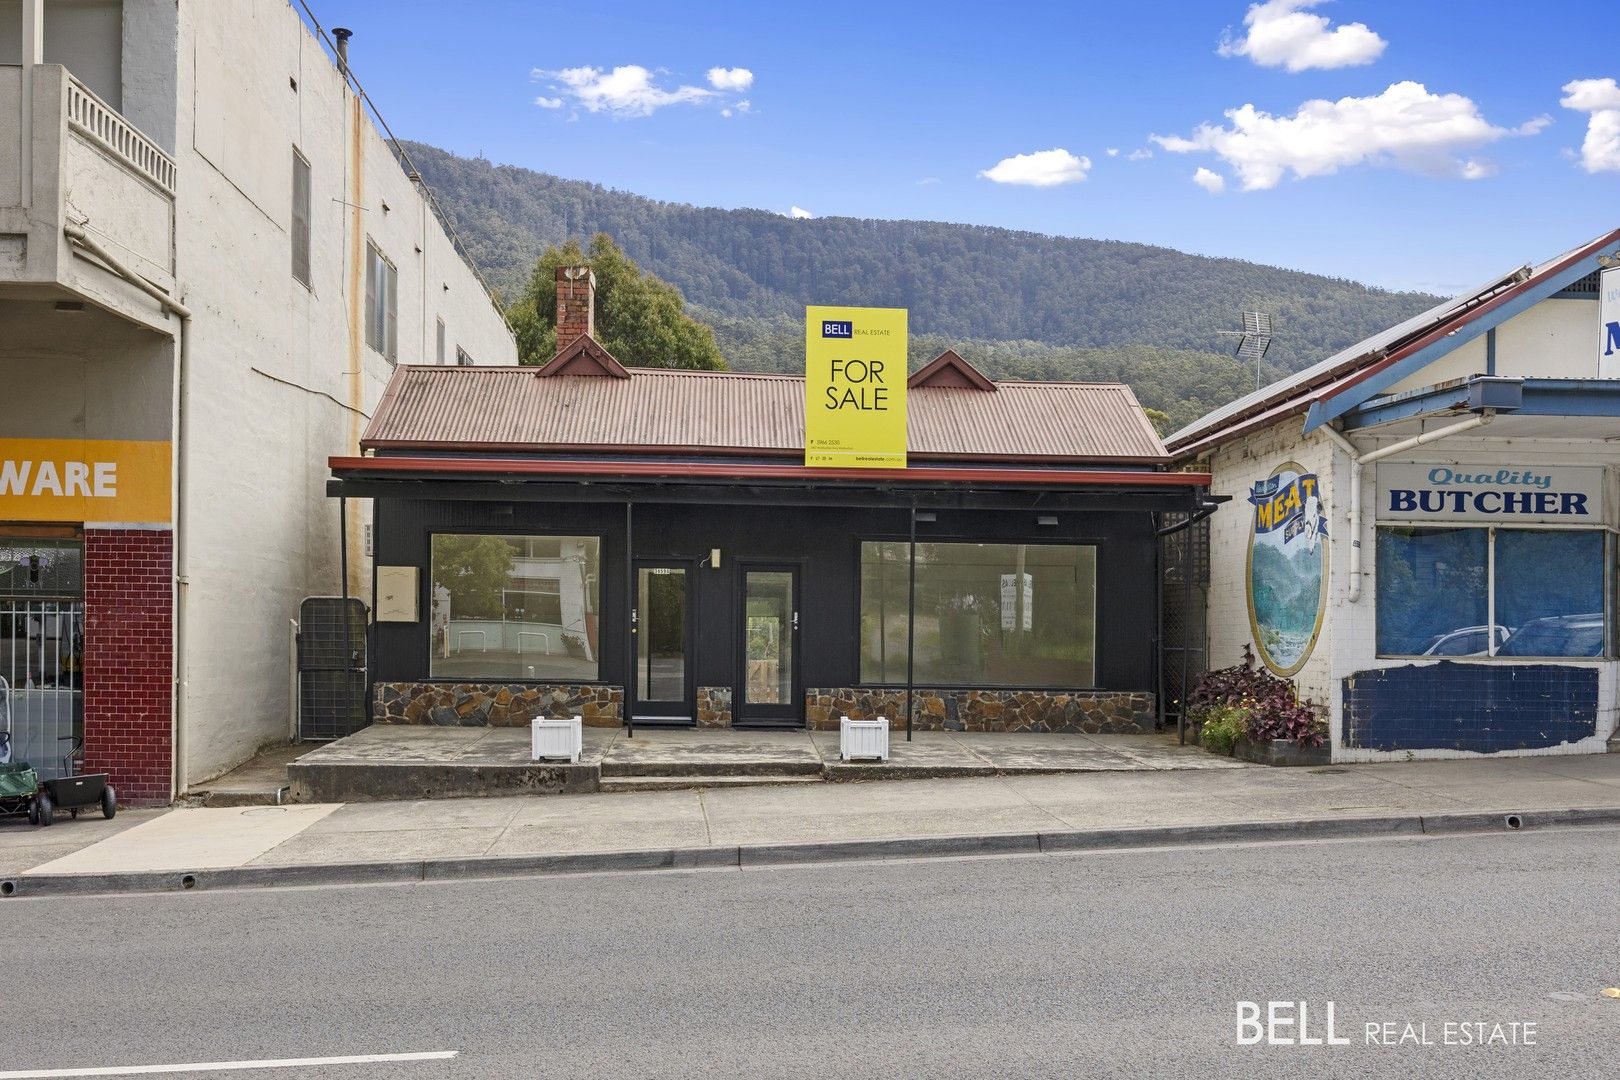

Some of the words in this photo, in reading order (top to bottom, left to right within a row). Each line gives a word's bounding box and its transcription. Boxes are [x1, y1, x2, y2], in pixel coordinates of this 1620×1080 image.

[824, 323, 850, 335] BELL
[831, 359, 884, 383] FOR
[825, 386, 888, 410] SALE
[0, 460, 117, 498] WARE
[1428, 467, 1552, 490] Quality
[1257, 479, 1316, 529] MEAT
[1388, 489, 1589, 515] BUTCHER
